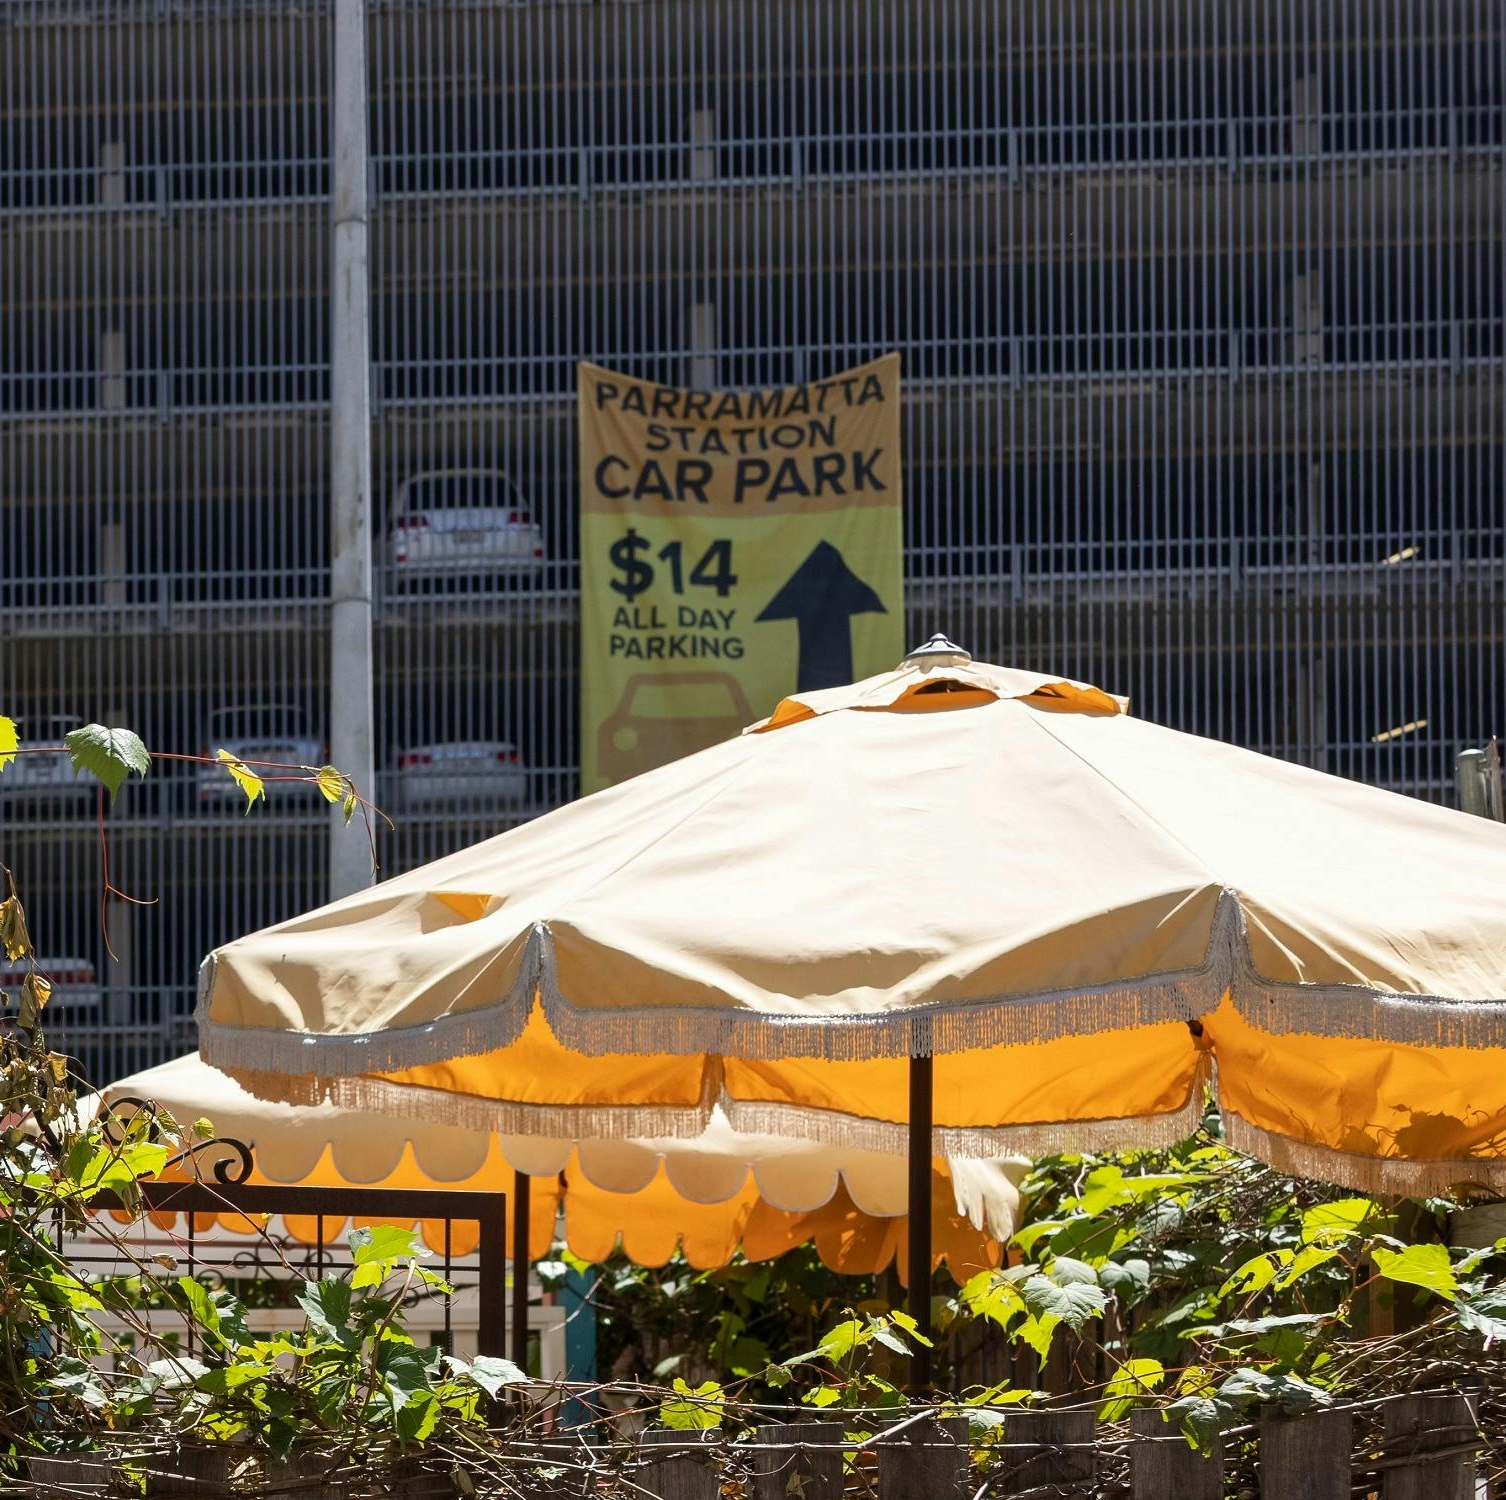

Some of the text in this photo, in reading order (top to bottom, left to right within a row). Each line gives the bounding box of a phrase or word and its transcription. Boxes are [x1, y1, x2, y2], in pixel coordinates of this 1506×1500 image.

[595, 373, 885, 421] PARRAMATTA
[646, 415, 836, 455] STATION
[594, 449, 888, 502] CAR PARK
[609, 529, 738, 602] $14
[613, 606, 736, 631] ALL DAY
[610, 634, 745, 660] PARKING
